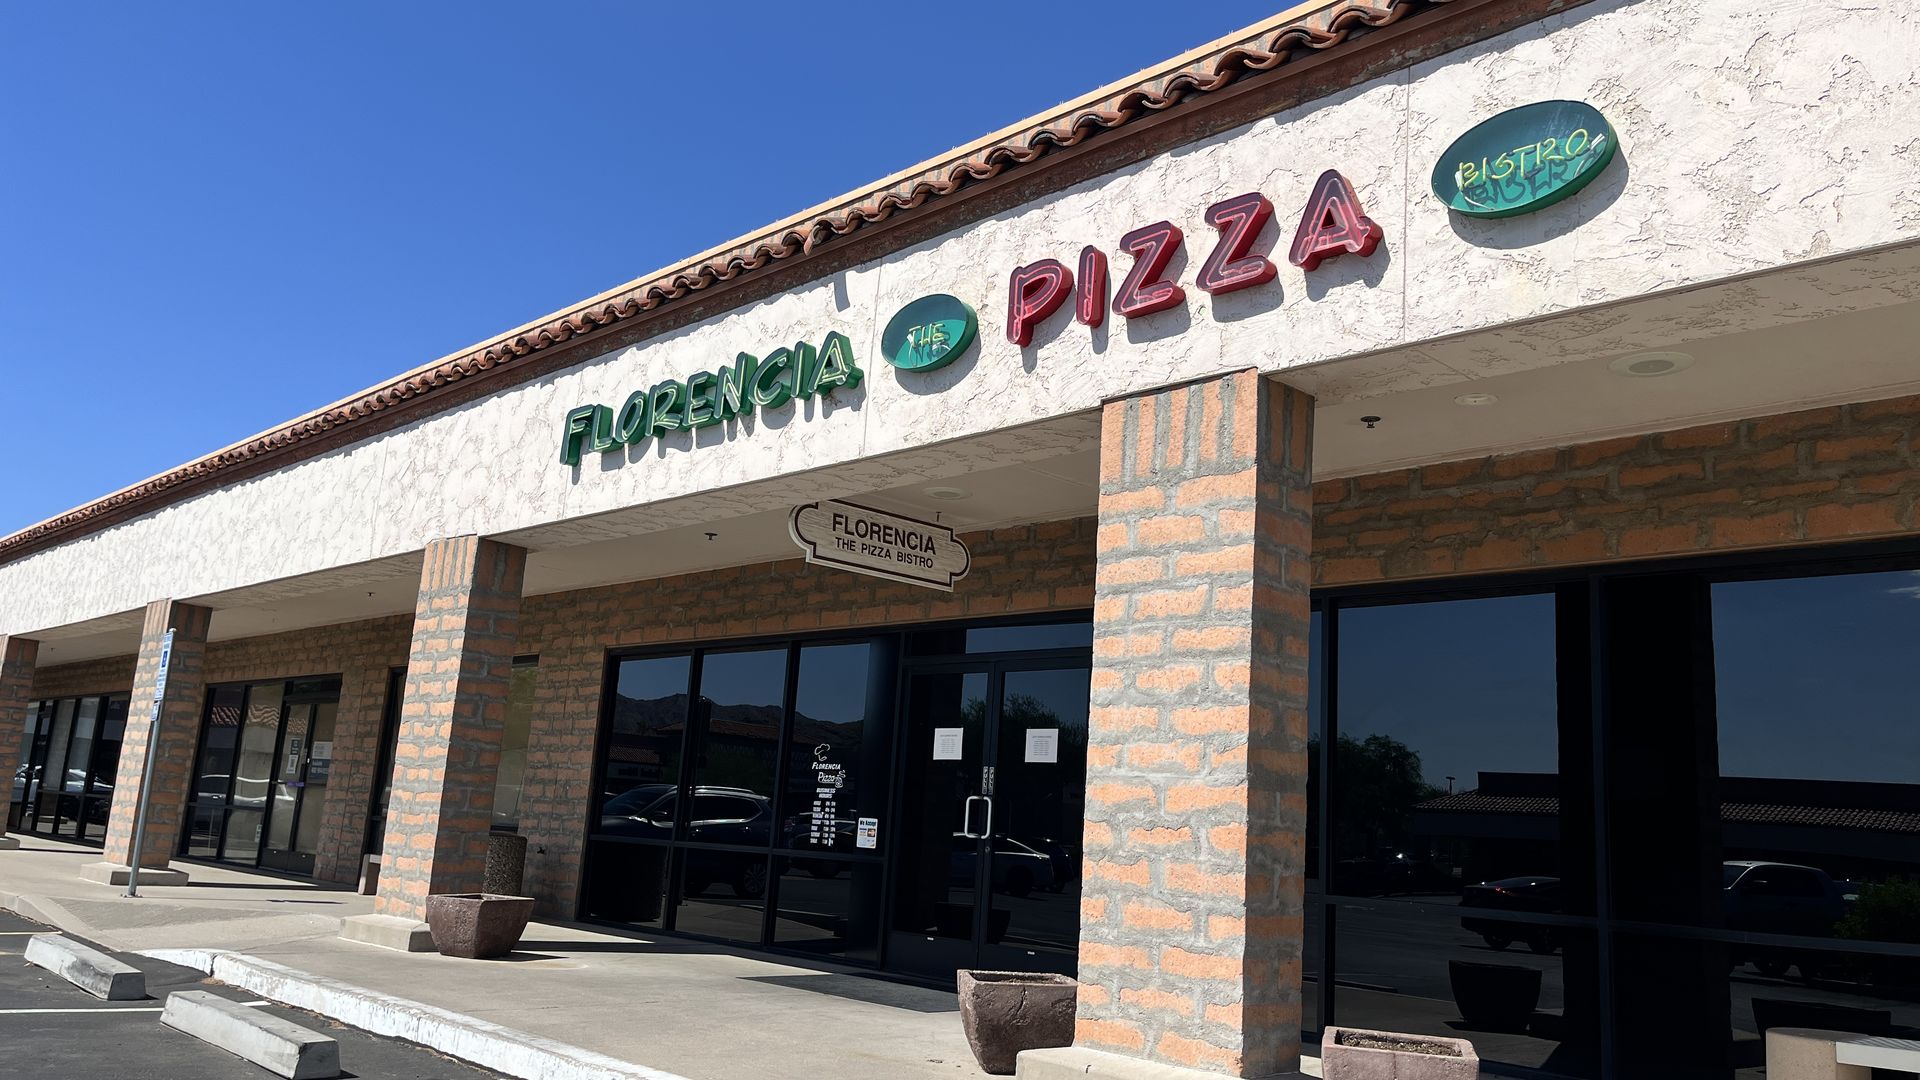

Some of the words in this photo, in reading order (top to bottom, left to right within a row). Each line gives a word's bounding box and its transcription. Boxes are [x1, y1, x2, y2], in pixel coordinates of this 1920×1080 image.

[1457, 128, 1588, 191] BISTRO
[1006, 168, 1383, 348] PIZZA
[908, 322, 945, 348] THE
[559, 330, 865, 468] FLORENCIA
[832, 512, 937, 556] FLORENCIA
[835, 536, 857, 552] THE
[861, 543, 892, 561] PIZZA
[896, 551, 934, 569] BISTRO
[811, 761, 841, 770] FLORENCIA
